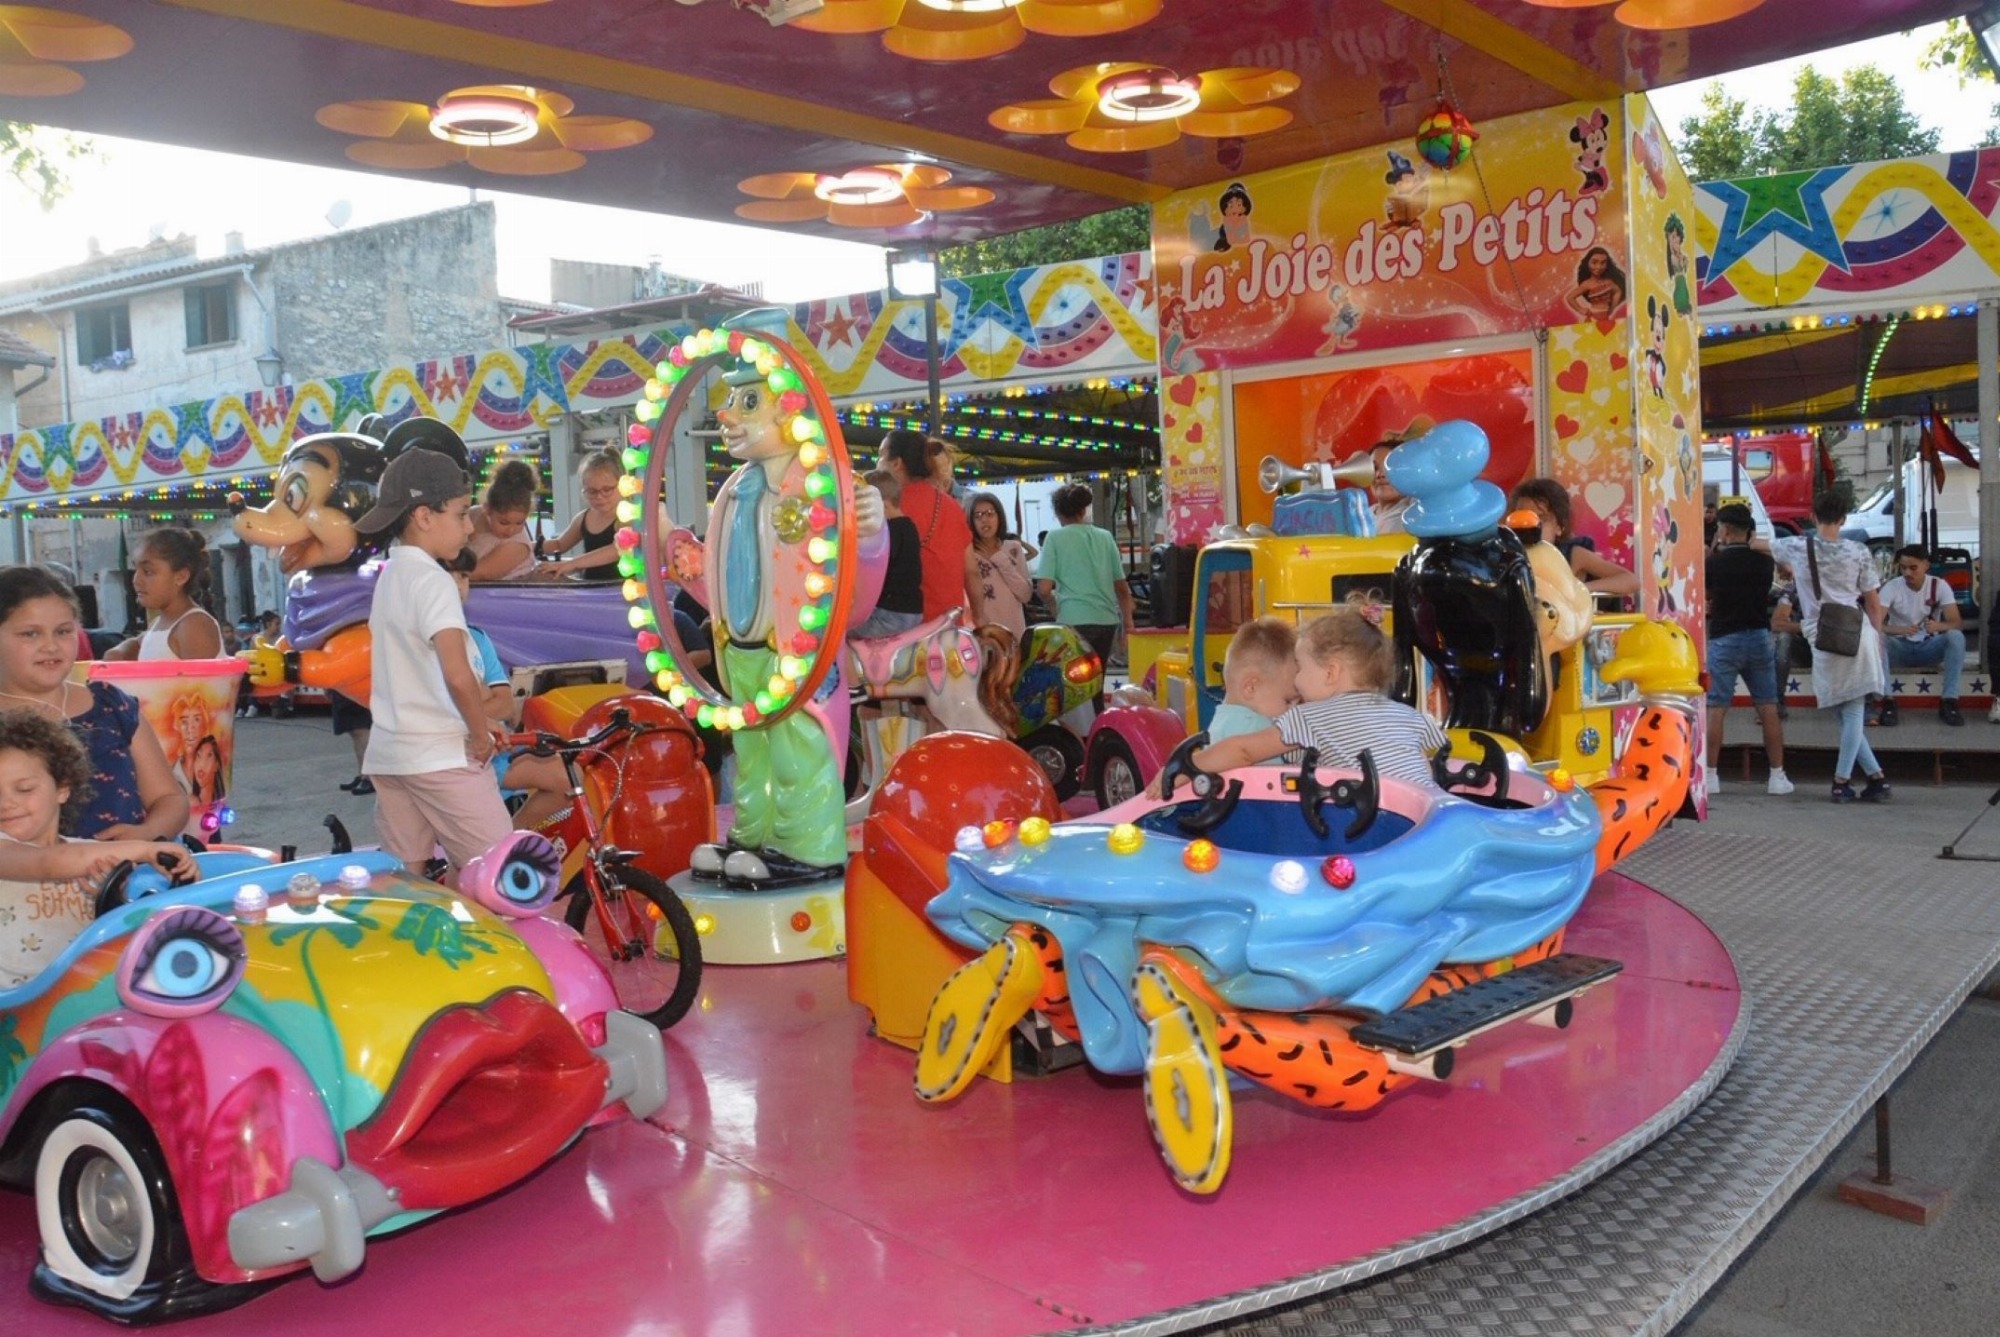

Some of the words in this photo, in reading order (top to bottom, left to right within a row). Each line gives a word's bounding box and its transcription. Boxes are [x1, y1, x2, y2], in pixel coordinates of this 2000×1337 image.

[1178, 254, 1227, 312] La
[1237, 232, 1332, 304] Joie
[1344, 218, 1424, 287] des
[1437, 187, 1598, 272] Petits
